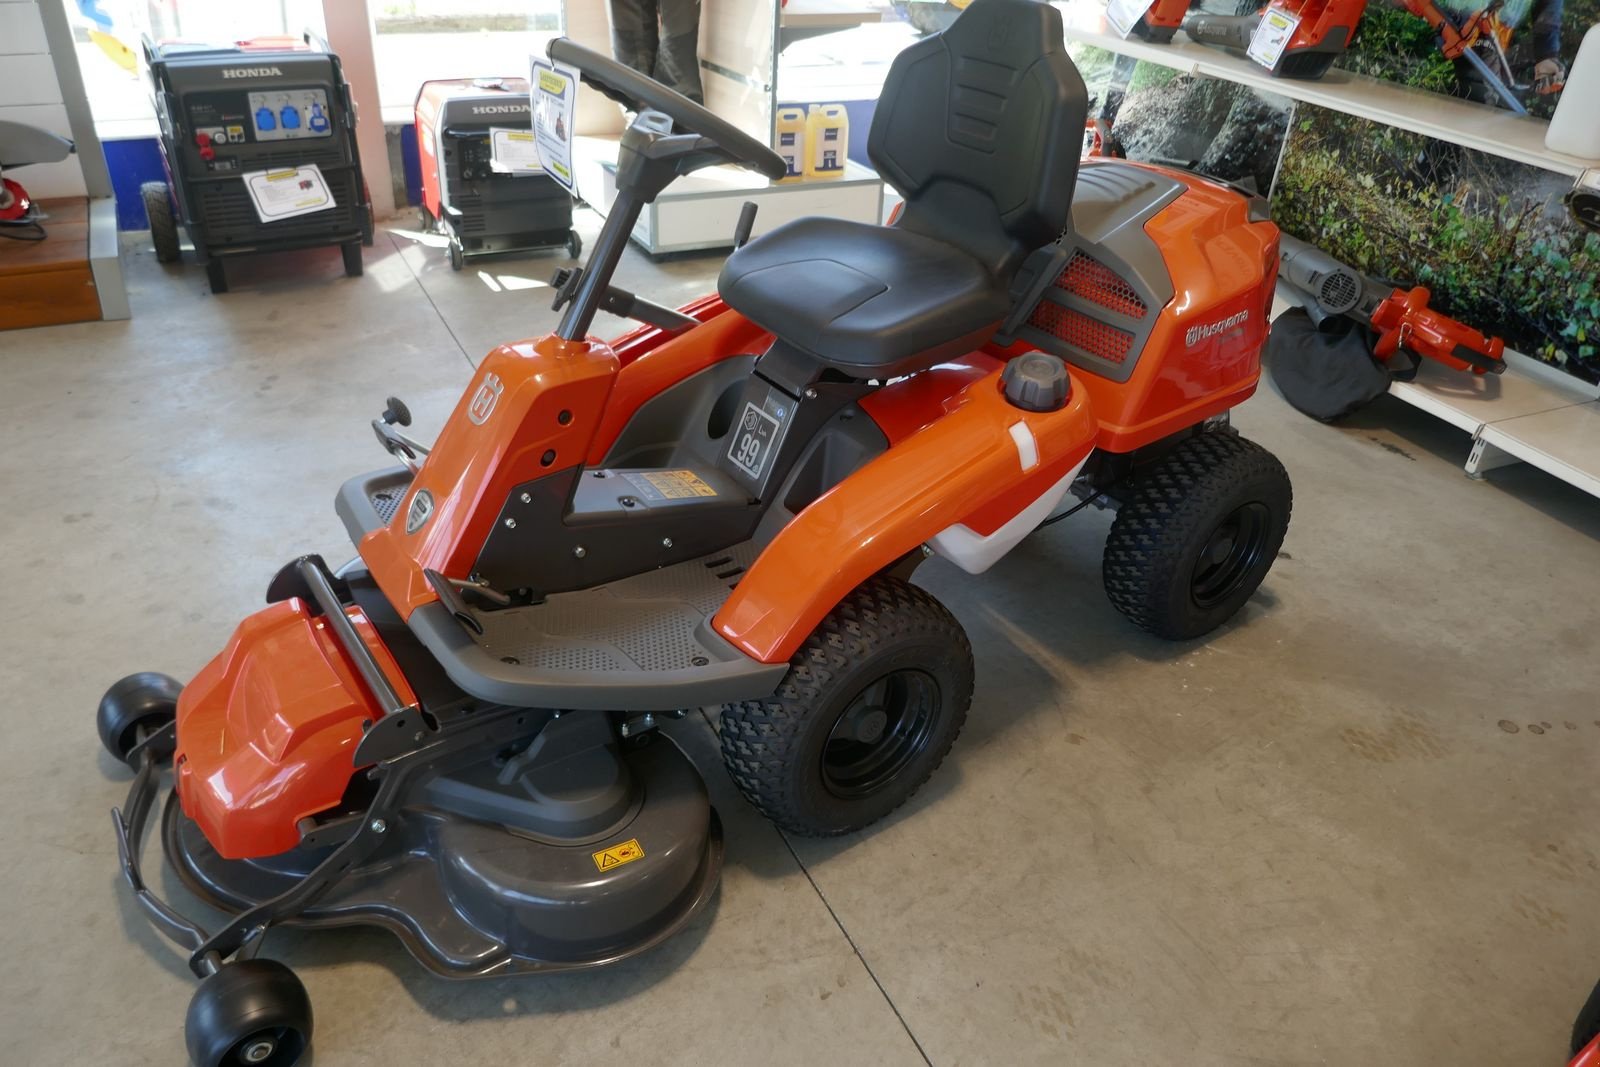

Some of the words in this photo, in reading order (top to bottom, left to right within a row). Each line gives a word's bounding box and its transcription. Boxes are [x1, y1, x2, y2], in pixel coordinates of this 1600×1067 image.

[222, 67, 283, 79] HONDA
[472, 104, 531, 114] HONDA
[1197, 310, 1248, 340] Husqvarna
[737, 433, 760, 468] 99
